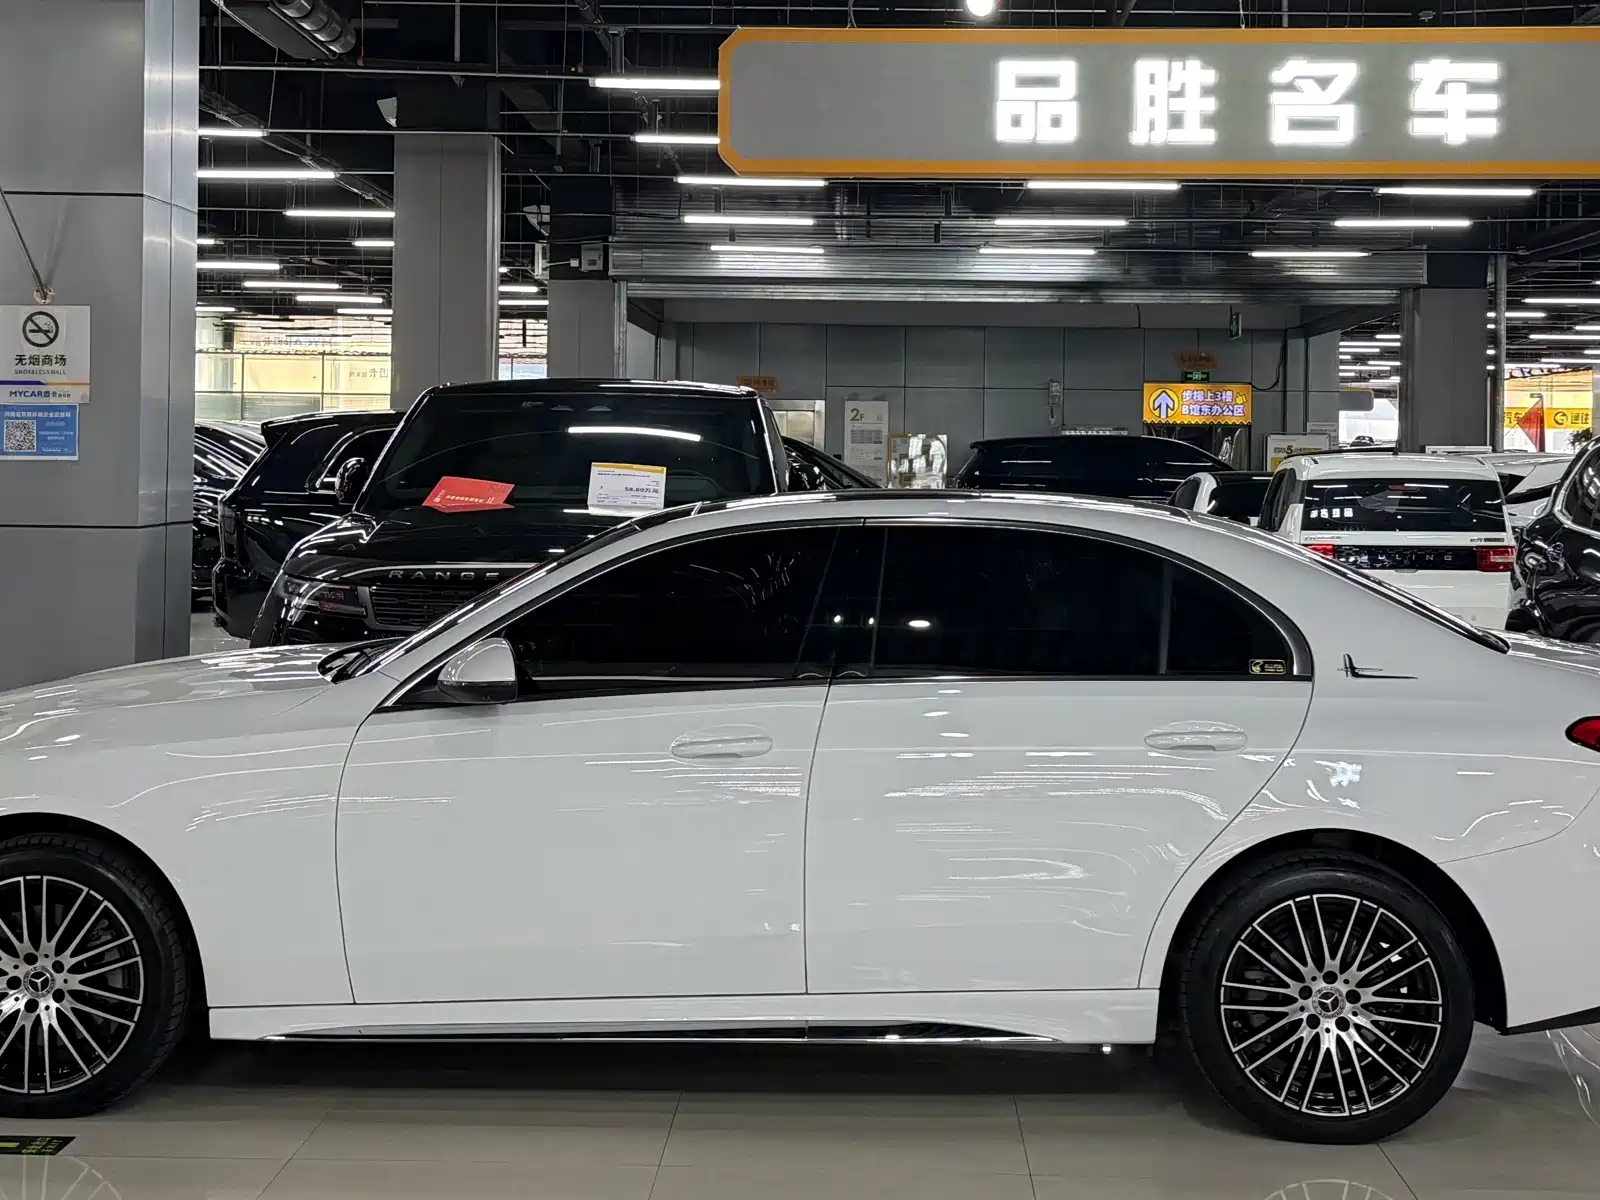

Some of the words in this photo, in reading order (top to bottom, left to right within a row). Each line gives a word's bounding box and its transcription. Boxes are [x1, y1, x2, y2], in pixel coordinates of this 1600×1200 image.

[995, 58, 1501, 145] 品胜名车
[14, 354, 67, 367] 无烟商场
[1181, 389, 1234, 403] 步梯上3楼
[1181, 404, 1245, 417] B馆东办公区
[388, 570, 500, 580] RANGE
